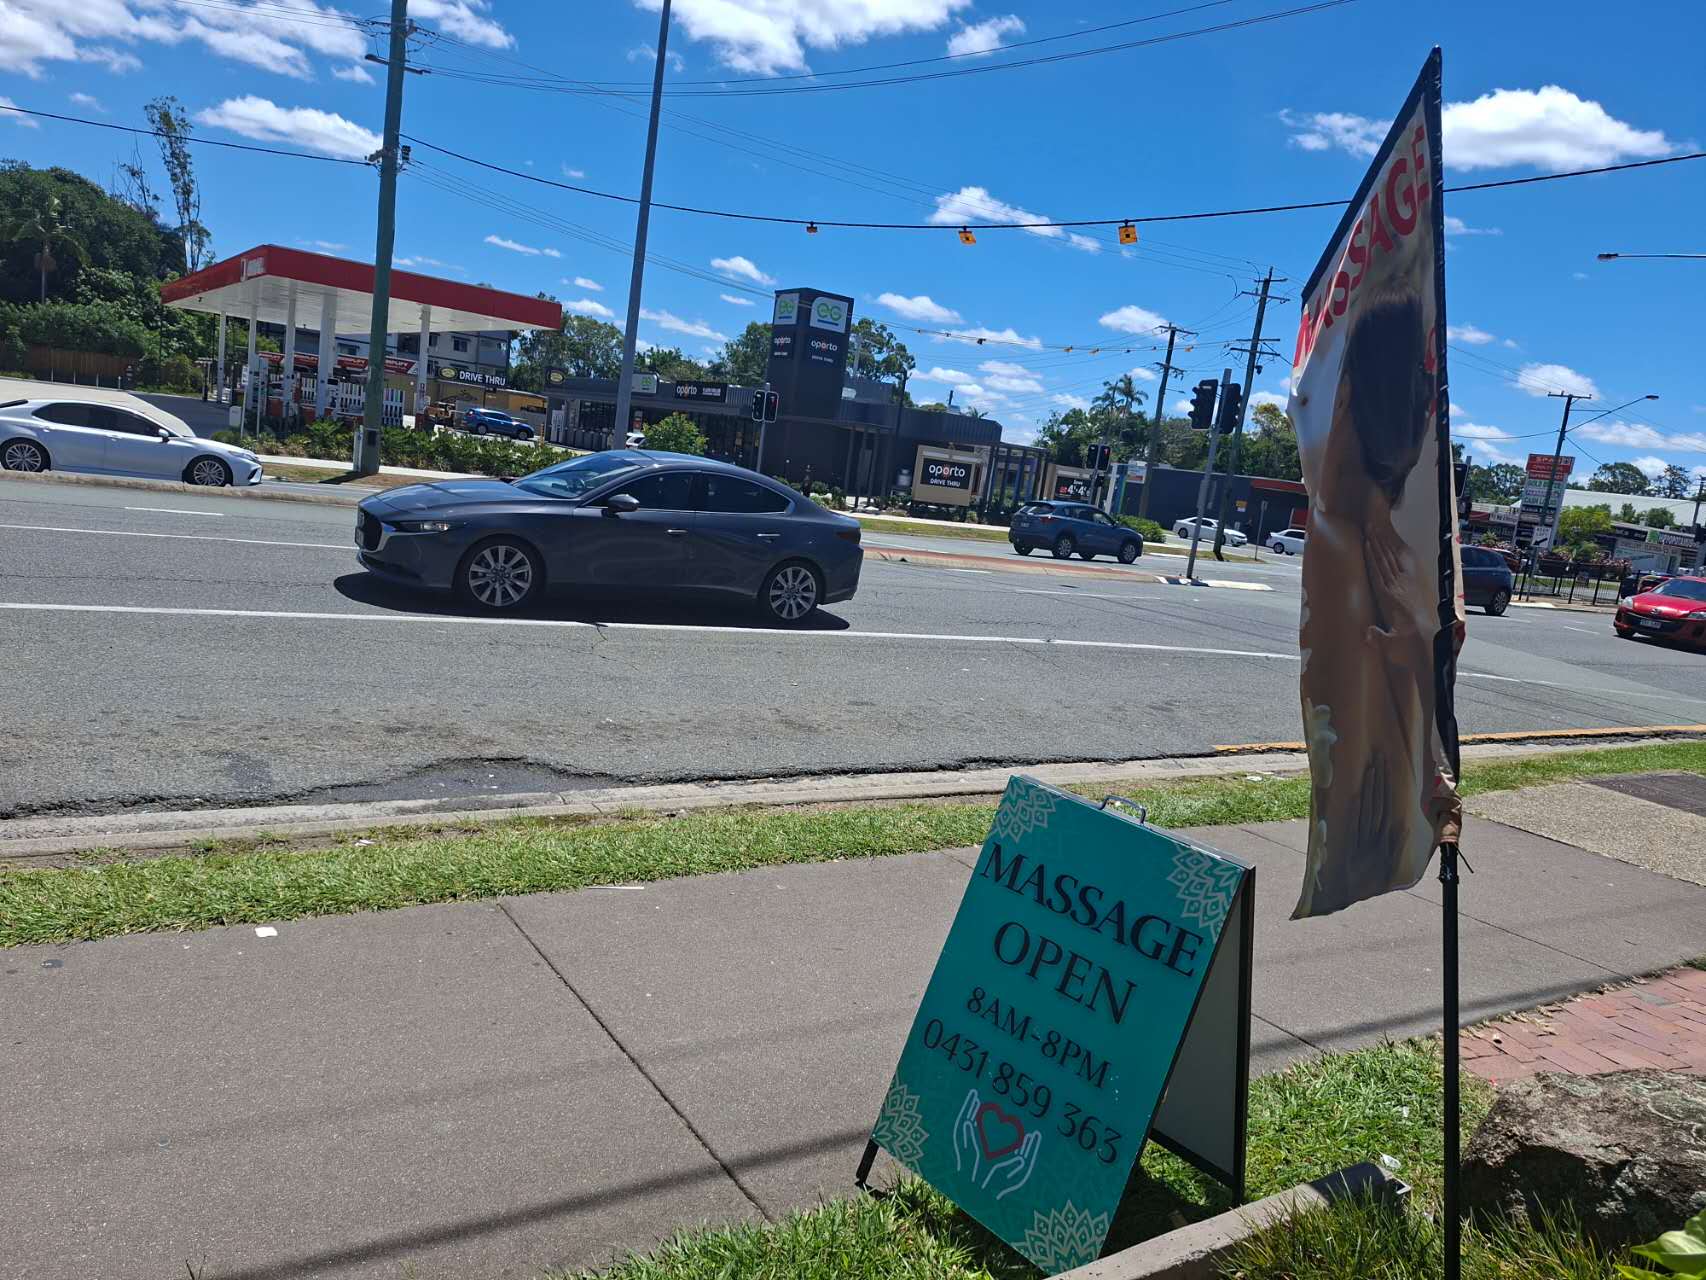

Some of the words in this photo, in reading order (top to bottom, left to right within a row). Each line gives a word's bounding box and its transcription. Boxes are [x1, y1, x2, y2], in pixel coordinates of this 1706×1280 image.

[811, 339, 838, 352] oporto
[459, 370, 483, 383] DRIVE
[485, 374, 506, 386] THRU
[676, 384, 698, 397] oporto
[928, 464, 966, 477] oporto
[929, 478, 946, 486] DRIVE
[946, 480, 961, 488] THRU
[981, 842, 1204, 977] MASSAGE
[993, 920, 1137, 1025] OPEN
[966, 986, 1113, 1089] 8AM-8PM
[924, 1018, 990, 1081] 0431
[992, 1061, 1053, 1119] 859
[1056, 1101, 1123, 1165] 363
